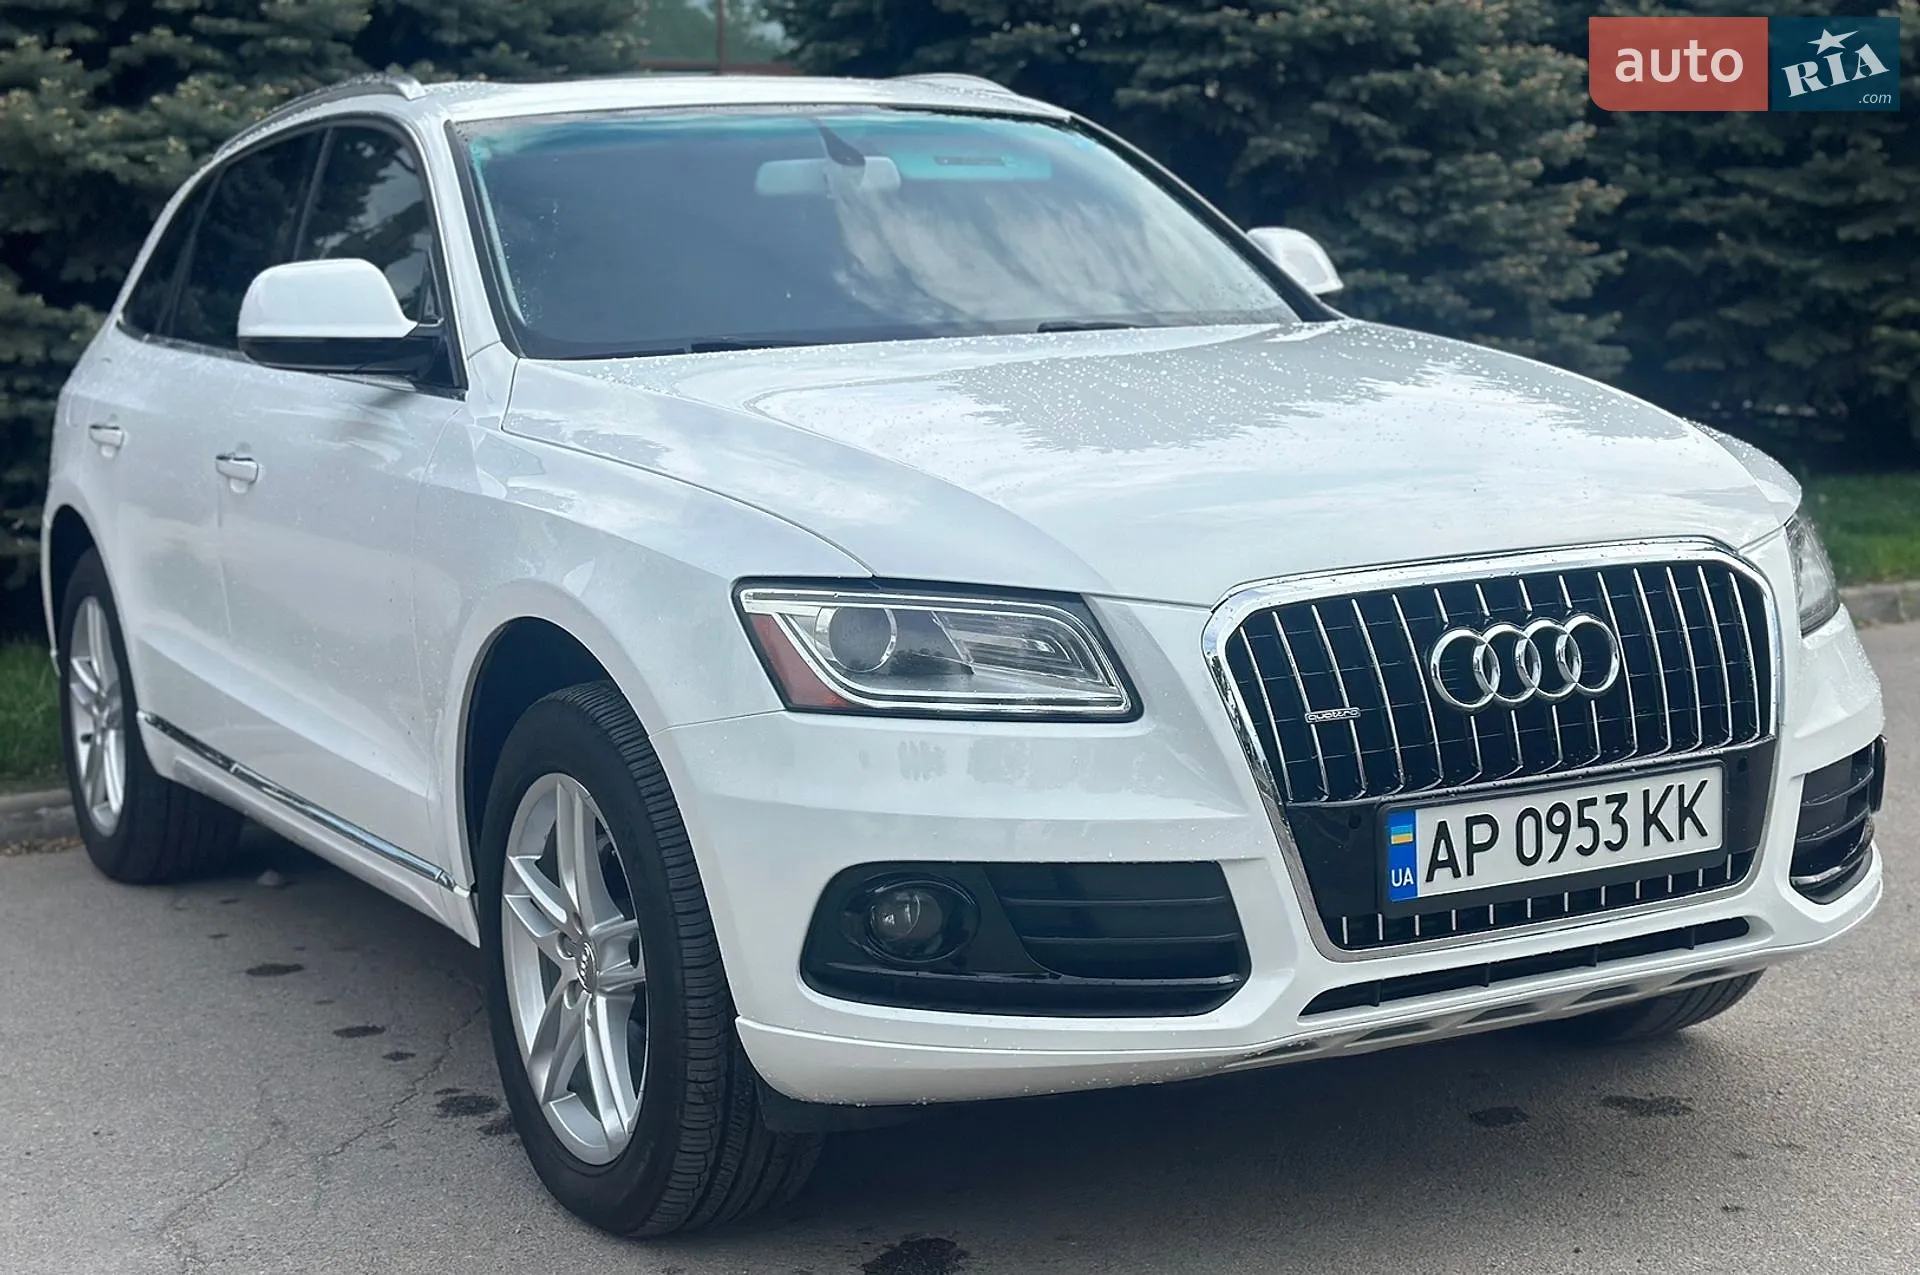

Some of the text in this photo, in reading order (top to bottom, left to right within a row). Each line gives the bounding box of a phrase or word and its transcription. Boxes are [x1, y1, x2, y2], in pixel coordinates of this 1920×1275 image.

[1425, 779, 1709, 882] AP 0953 KK
[1391, 869, 1415, 888] UA
